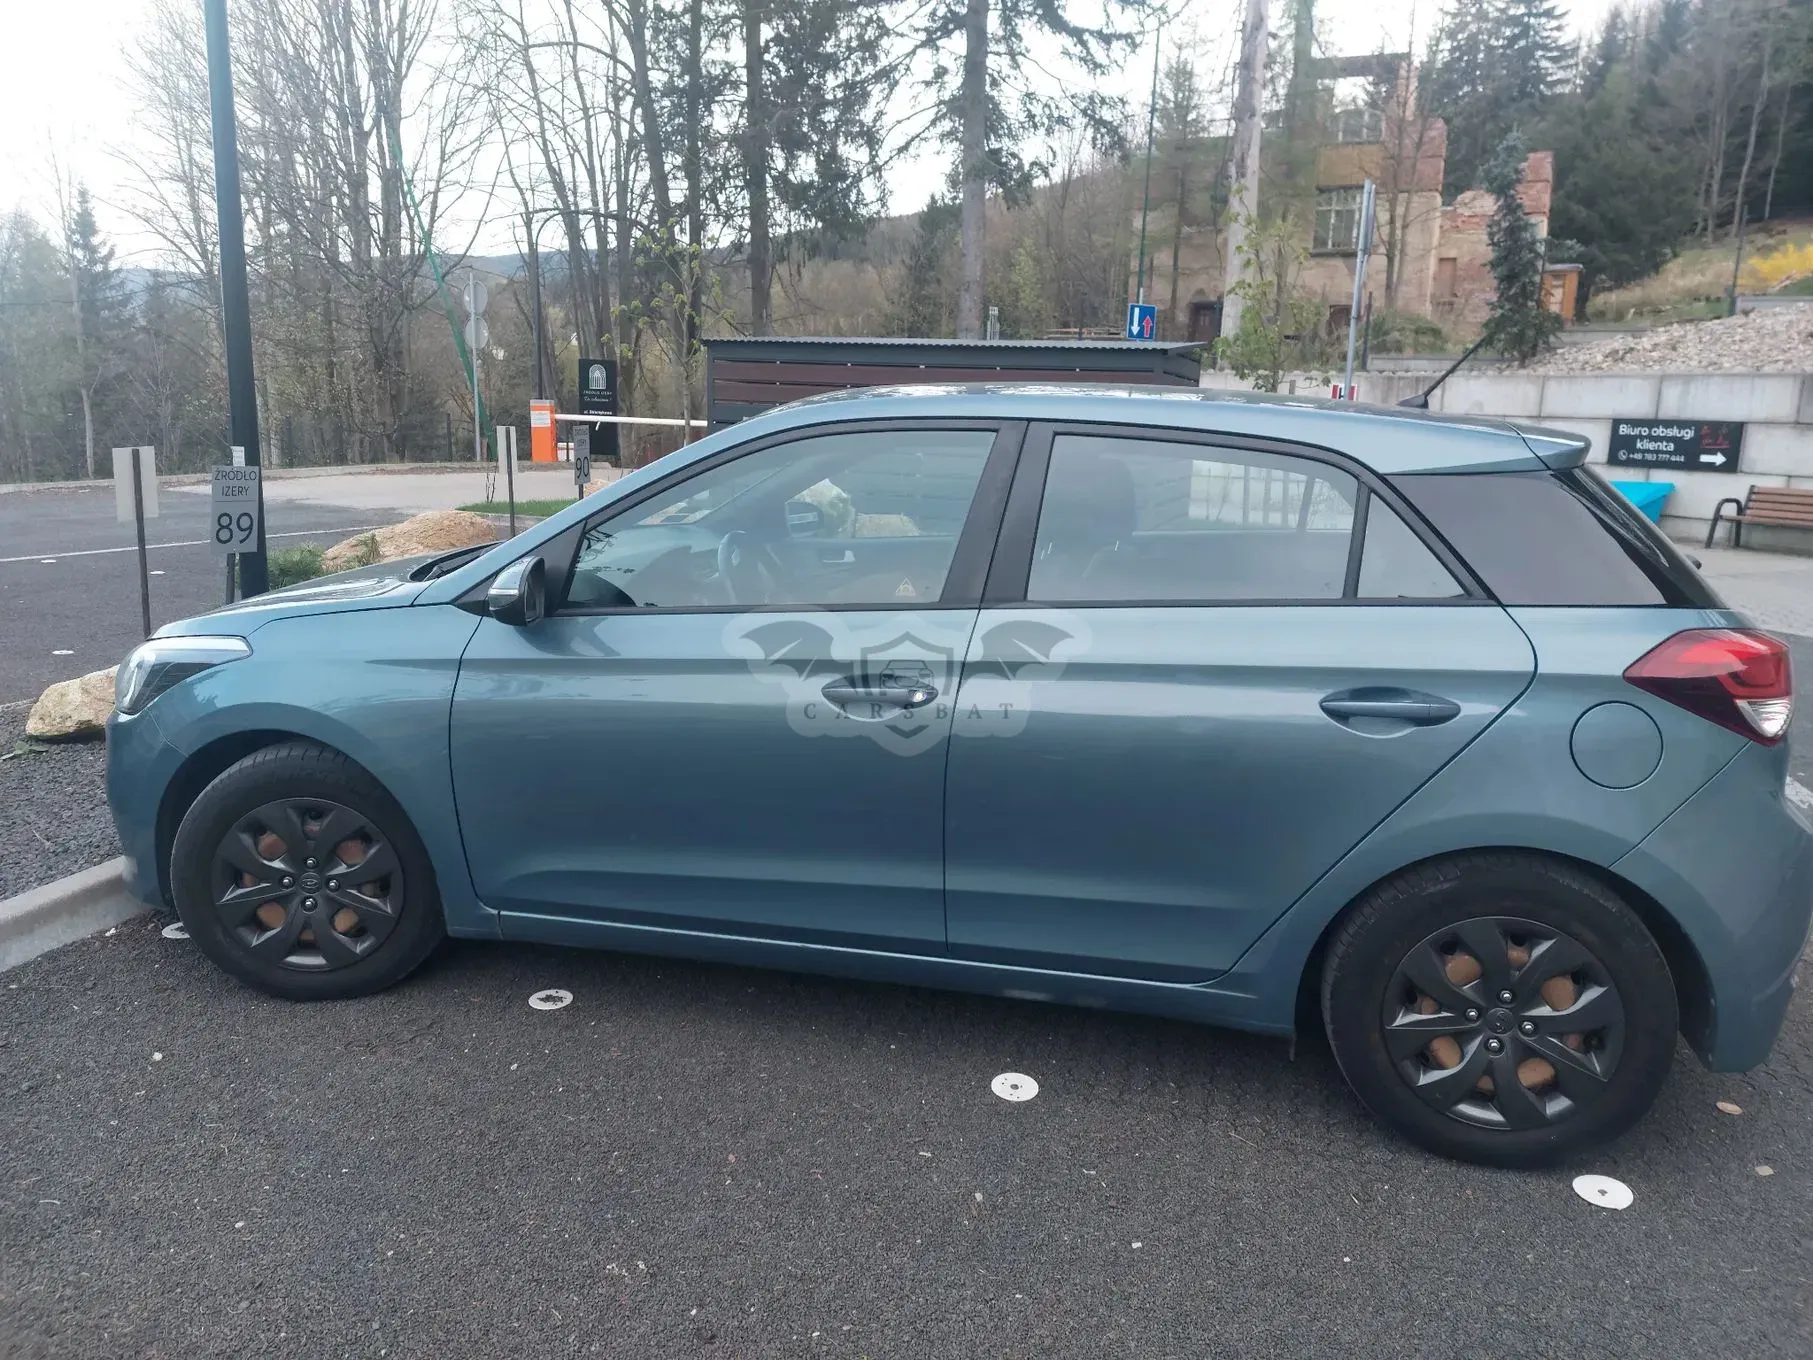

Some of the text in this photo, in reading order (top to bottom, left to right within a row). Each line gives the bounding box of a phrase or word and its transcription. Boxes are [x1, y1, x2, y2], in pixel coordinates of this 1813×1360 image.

[1619, 424, 1695, 440] Biuro obsługi
[1636, 438, 1675, 451] klienta
[215, 468, 257, 480] ŹRÓDŁO
[575, 456, 590, 479] 90
[221, 485, 249, 496] IZERY
[216, 512, 254, 544] 89
